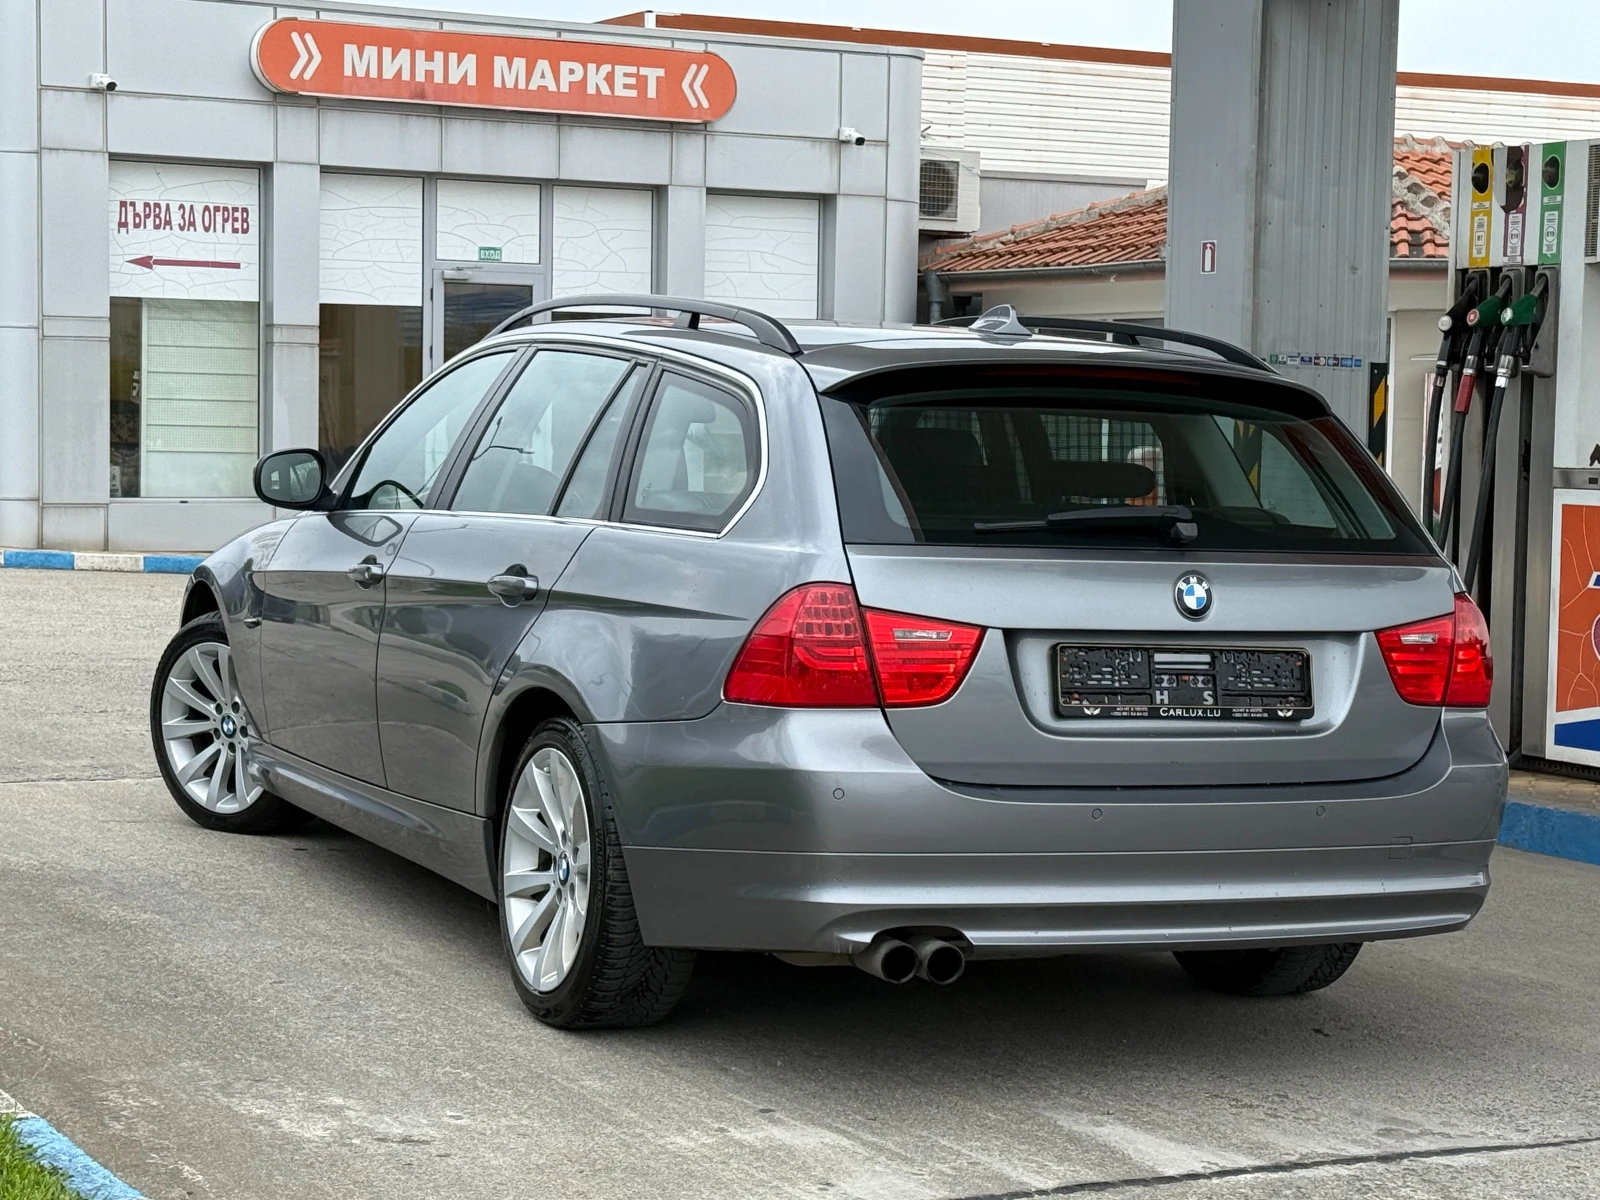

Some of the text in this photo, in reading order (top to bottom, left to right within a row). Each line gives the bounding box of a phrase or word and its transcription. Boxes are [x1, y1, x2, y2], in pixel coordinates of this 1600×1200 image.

[343, 44, 666, 99] МИНИ МАРКЕТ
[117, 200, 250, 235] ДЪРВА ЗА ОГРЕВ
[480, 249, 501, 260] ВХОД
[1155, 690, 1214, 705] H S
